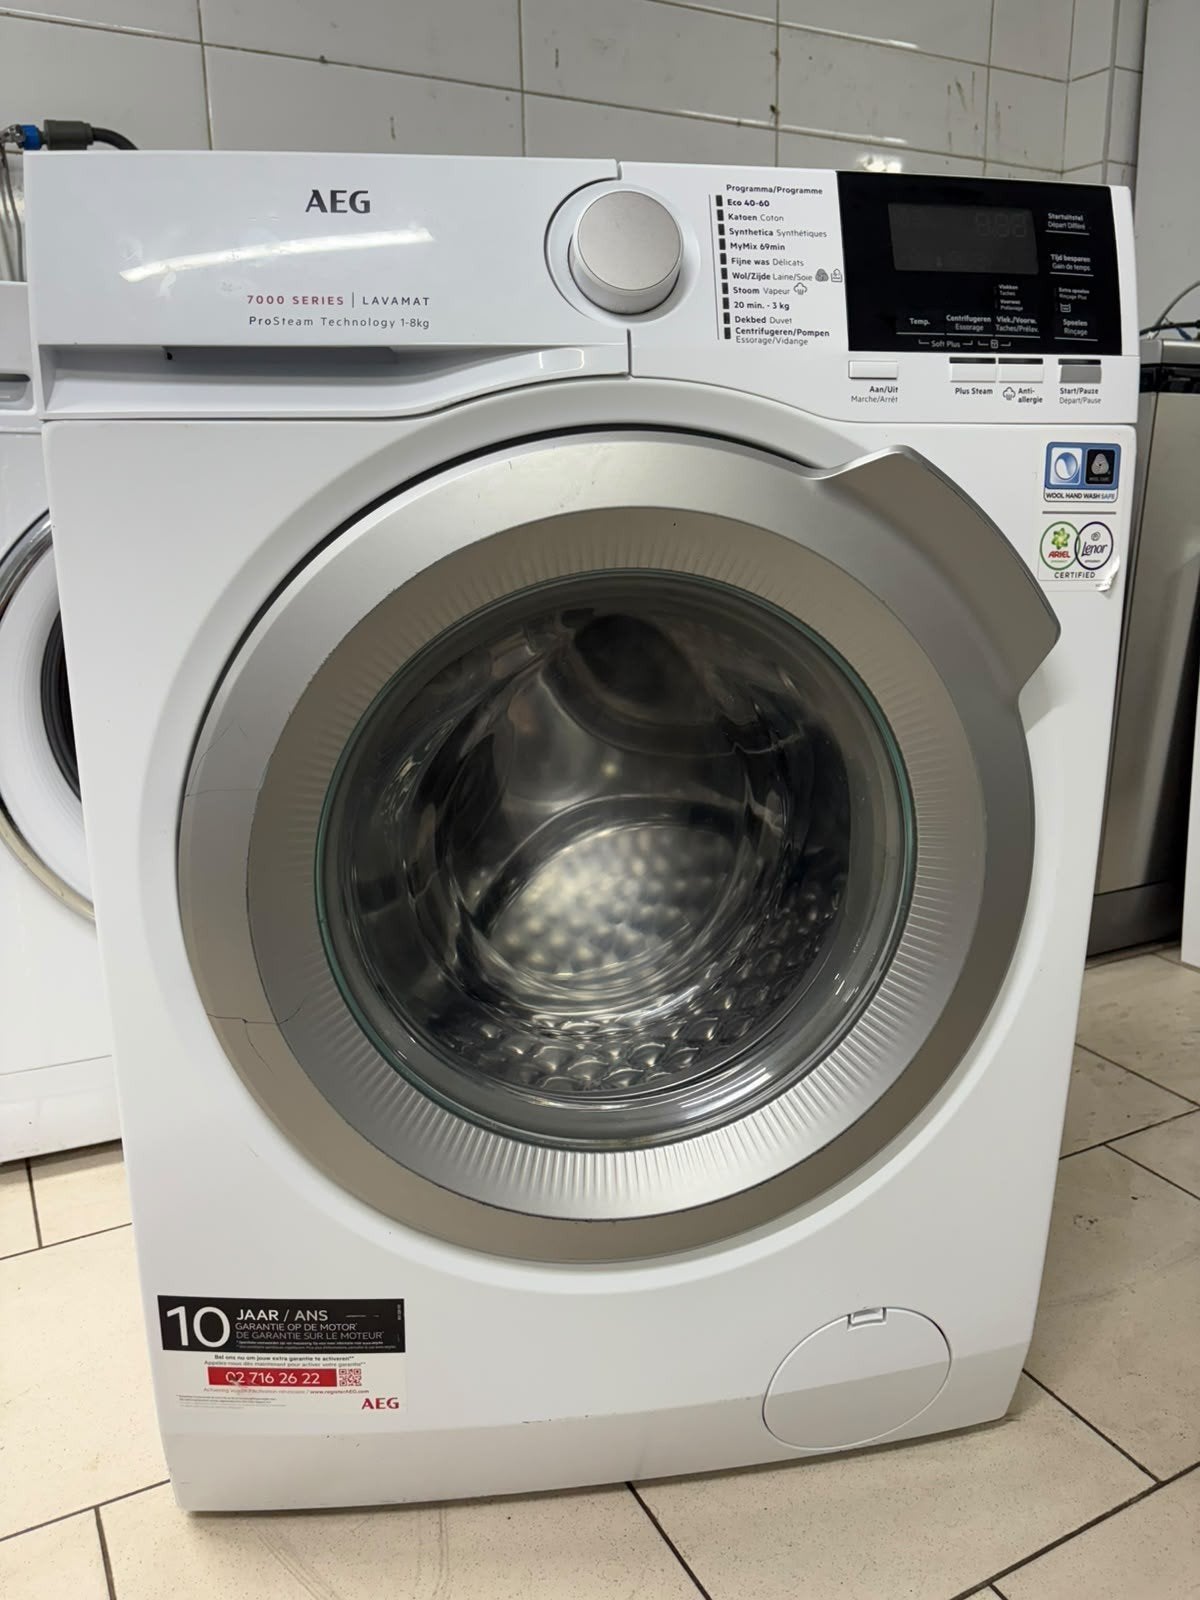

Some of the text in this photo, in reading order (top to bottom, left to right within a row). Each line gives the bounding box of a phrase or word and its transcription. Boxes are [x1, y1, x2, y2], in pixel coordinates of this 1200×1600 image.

[726, 184, 823, 195] Programma/Programme
[305, 189, 371, 214] AEG
[727, 198, 770, 208] Eco 40-60
[728, 212, 784, 223] Katoen Coton
[729, 227, 827, 239] Synthetica Synthétiques
[730, 242, 786, 253] MyMix 69min
[731, 257, 752, 267] Fijne
[732, 272, 813, 281] Wol/Zijde Laine/Soie
[733, 286, 791, 296] Stoom Vapeur
[247, 295, 430, 306] 7000 SERIES LAVAMAT
[734, 301, 744, 309] 20
[772, 302, 777, 310] 3
[780, 302, 790, 311] kg
[249, 316, 430, 330] ProSteam Technology 1-8kg
[735, 316, 792, 325] Dekbed Duvet
[909, 317, 931, 326] Temp.
[946, 314, 991, 324] Centrifugeren
[1063, 318, 1088, 327] Spoelen
[735, 326, 830, 337] Centrifugeren/Pompen
[955, 323, 984, 332] Essorage
[735, 336, 808, 346] Essorage/Vidange
[931, 340, 946, 348] Soft
[869, 386, 899, 394] Aan/Uit
[955, 387, 993, 396] Plus Steam
[1018, 387, 1036, 395] Anti-
[850, 394, 899, 404] Marche/Arrêt
[1017, 395, 1043, 405] allergie
[1081, 541, 1108, 557] Lenor
[1048, 550, 1071, 559] ARIEL
[1054, 571, 1096, 579] CERTIFIED
[236, 1309, 278, 1321] JAAR
[294, 1310, 328, 1321] ANS
[166, 1305, 231, 1348] 10
[235, 1322, 284, 1331] GARANTIE
[287, 1323, 301, 1331] OP
[304, 1323, 317, 1331] DE
[236, 1331, 249, 1340] DE
[251, 1331, 301, 1340] GARANTIE
[303, 1332, 323, 1340] SUR
[326, 1332, 338, 1340] LE
[225, 1371, 321, 1384] 02 716 26 22
[361, 1398, 400, 1410] AEG
